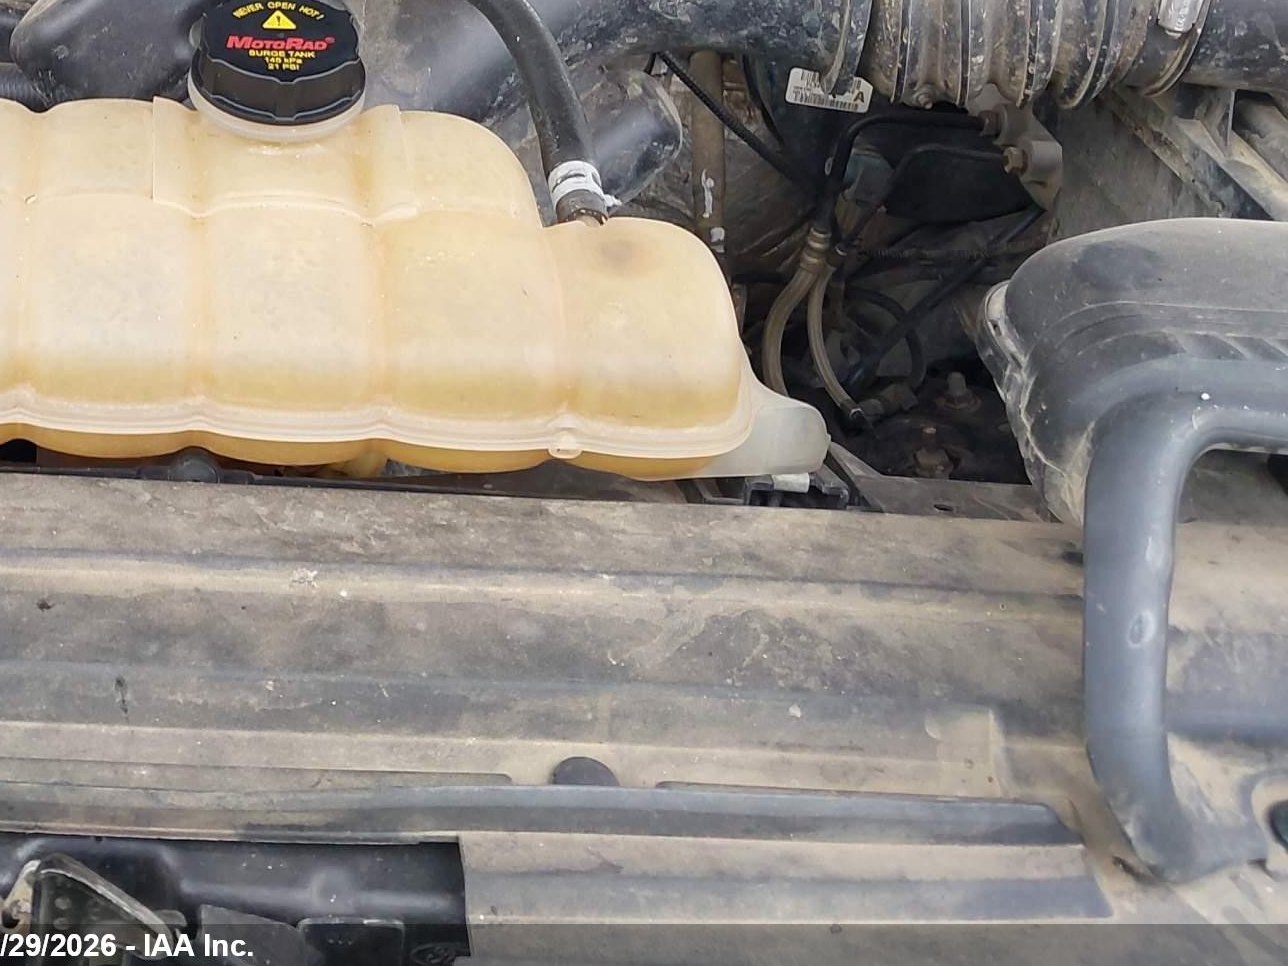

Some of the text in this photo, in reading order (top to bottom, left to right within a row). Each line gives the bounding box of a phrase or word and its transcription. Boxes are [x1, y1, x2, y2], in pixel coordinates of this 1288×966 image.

[232, 1, 325, 20] NEVER OPEN HOT!
[248, 49, 316, 59] SURGE TANK
[282, 63, 300, 71] PSI
